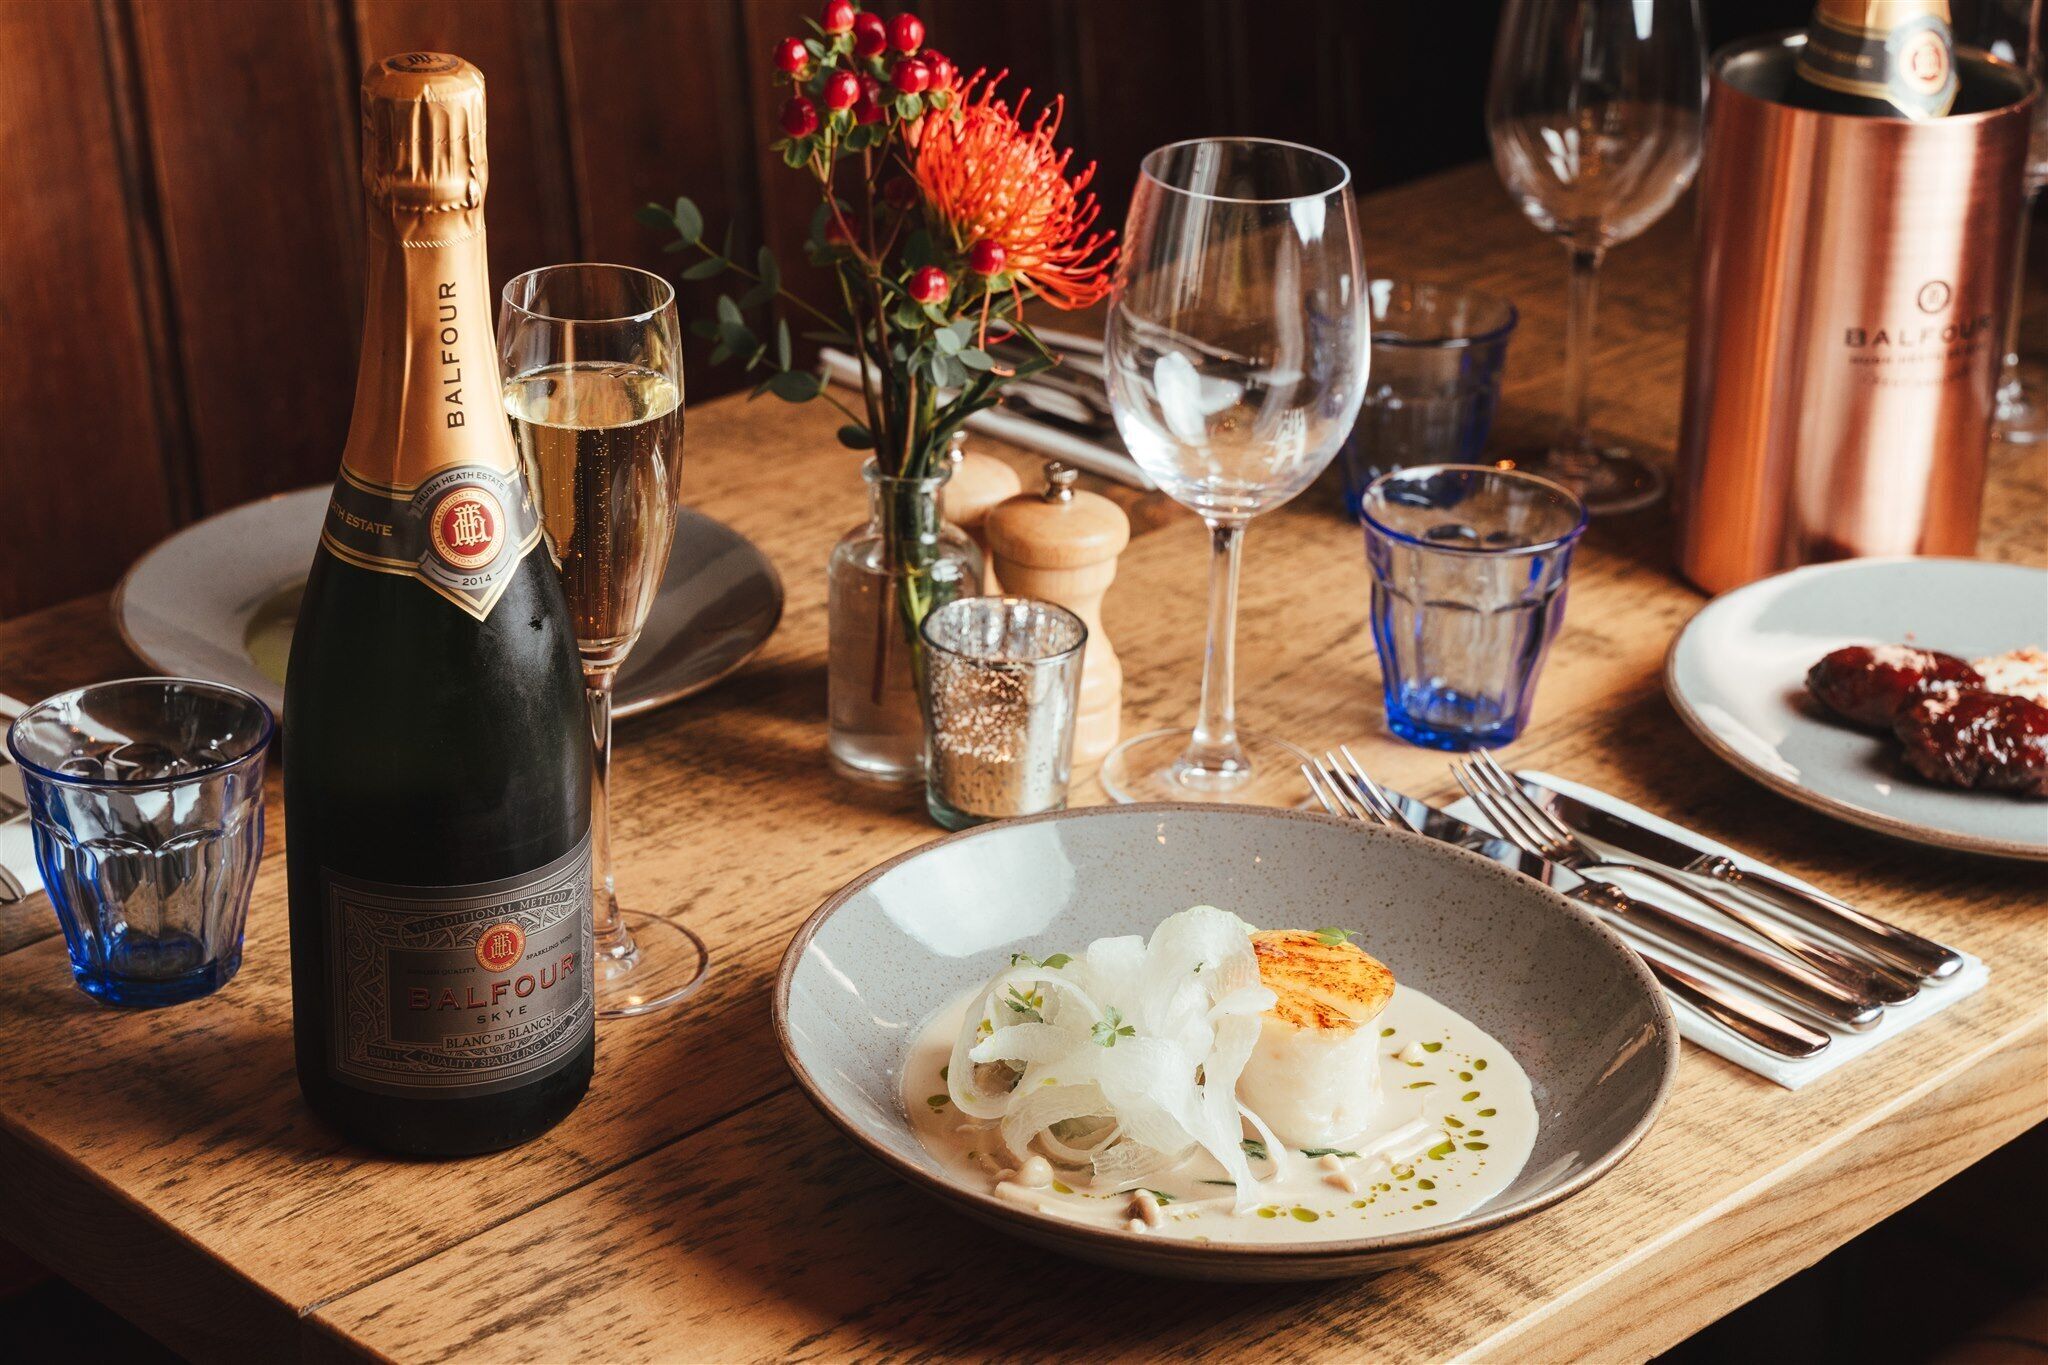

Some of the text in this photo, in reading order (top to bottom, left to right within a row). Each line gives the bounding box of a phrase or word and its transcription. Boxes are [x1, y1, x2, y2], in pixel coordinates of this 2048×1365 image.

[438, 281, 465, 429] BALFOUR
[416, 471, 505, 506] HUSH HEATH ESTATE
[346, 513, 393, 537] ESTATE
[462, 573, 493, 587] 2014
[412, 890, 568, 934] TRADITIONAL METHOD
[525, 932, 574, 961] SPARKLING WINE
[407, 952, 578, 1011] BALFOUR
[441, 966, 477, 976] QUALITY
[445, 1033, 492, 1050] BLANC
[508, 1015, 552, 1040] BLANCS
[476, 1005, 528, 1025] SKYE
[420, 1022, 568, 1069] QUALITY SPARKLING WINE
